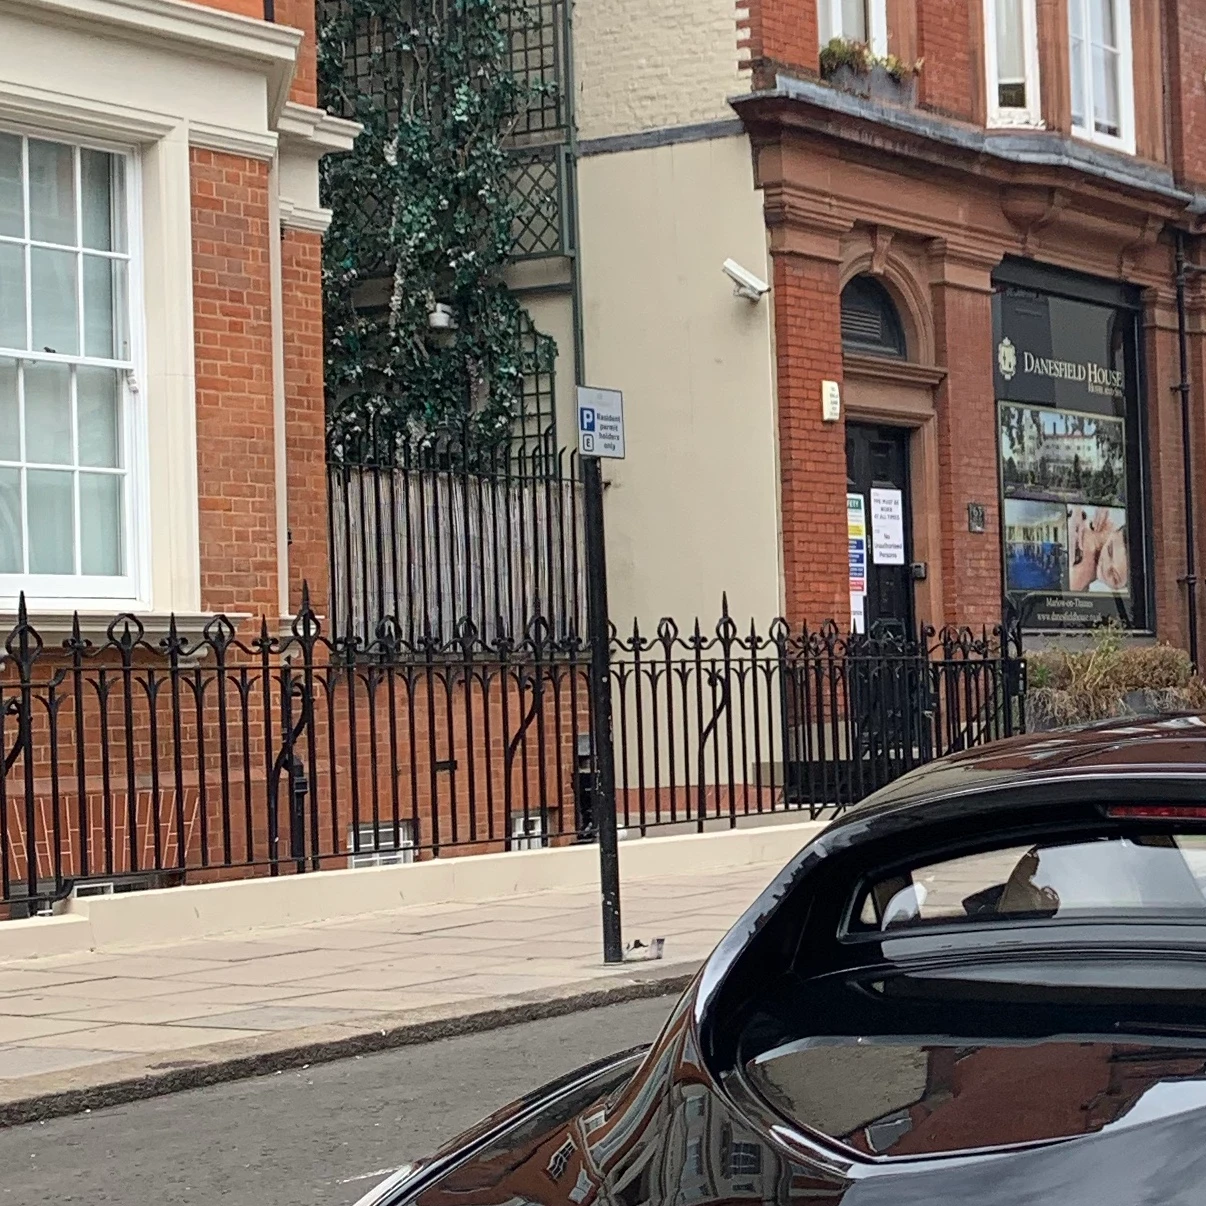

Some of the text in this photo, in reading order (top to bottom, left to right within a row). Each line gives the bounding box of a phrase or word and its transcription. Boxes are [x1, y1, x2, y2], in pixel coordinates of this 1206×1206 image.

[1023, 352, 1124, 386] DANESFIELD HOUSE
[583, 409, 593, 430] P
[597, 413, 620, 422] Resident
[599, 432, 619, 440] holders
[604, 442, 615, 451] only
